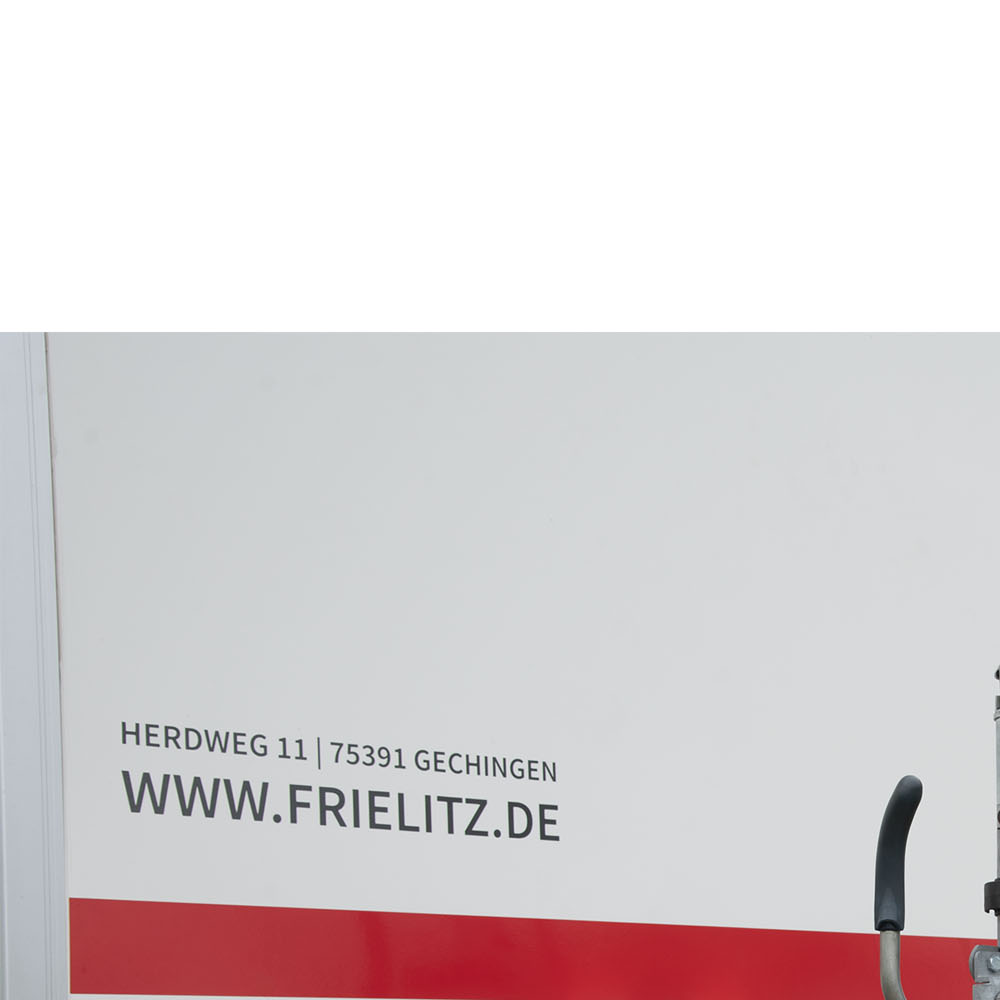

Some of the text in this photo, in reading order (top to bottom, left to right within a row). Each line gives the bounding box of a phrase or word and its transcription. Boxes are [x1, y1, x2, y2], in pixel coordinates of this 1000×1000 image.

[121, 721, 269, 758] HERDWEG
[277, 736, 308, 761] 11
[329, 741, 407, 770] 75391
[414, 749, 558, 783] GECHINGEN
[121, 769, 561, 841] WWW.FRIELITZ.DE
